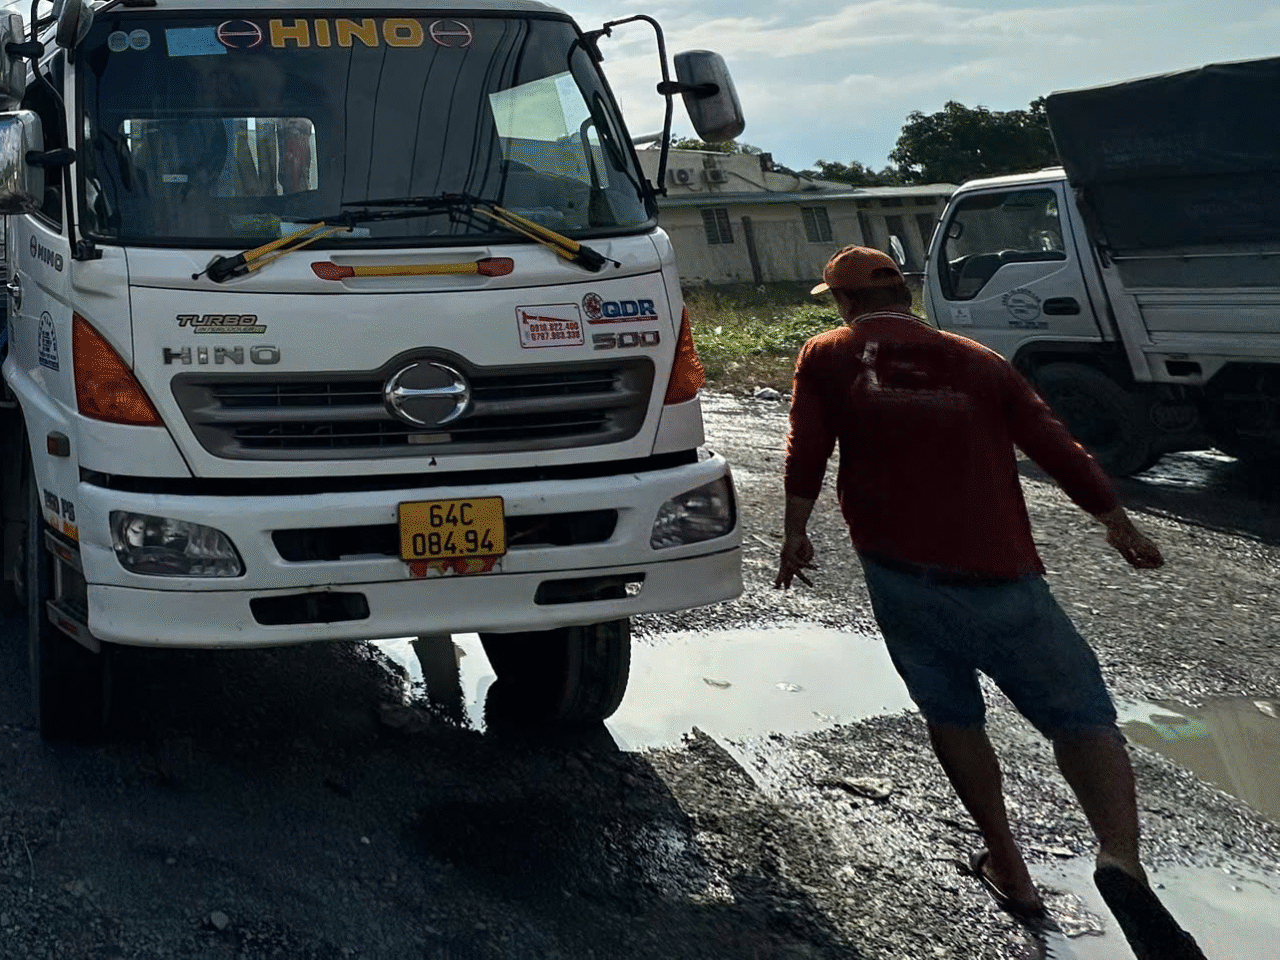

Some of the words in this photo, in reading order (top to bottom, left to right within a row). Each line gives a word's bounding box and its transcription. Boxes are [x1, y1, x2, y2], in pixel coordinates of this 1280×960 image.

[269, 17, 424, 48] HINO
[38, 243, 64, 272] HINO
[602, 299, 657, 317] QDR
[176, 314, 258, 327] TURBO
[591, 330, 661, 351] 500
[162, 345, 281, 365] HINO
[429, 502, 474, 528] 64C
[412, 528, 495, 556] 084.94
